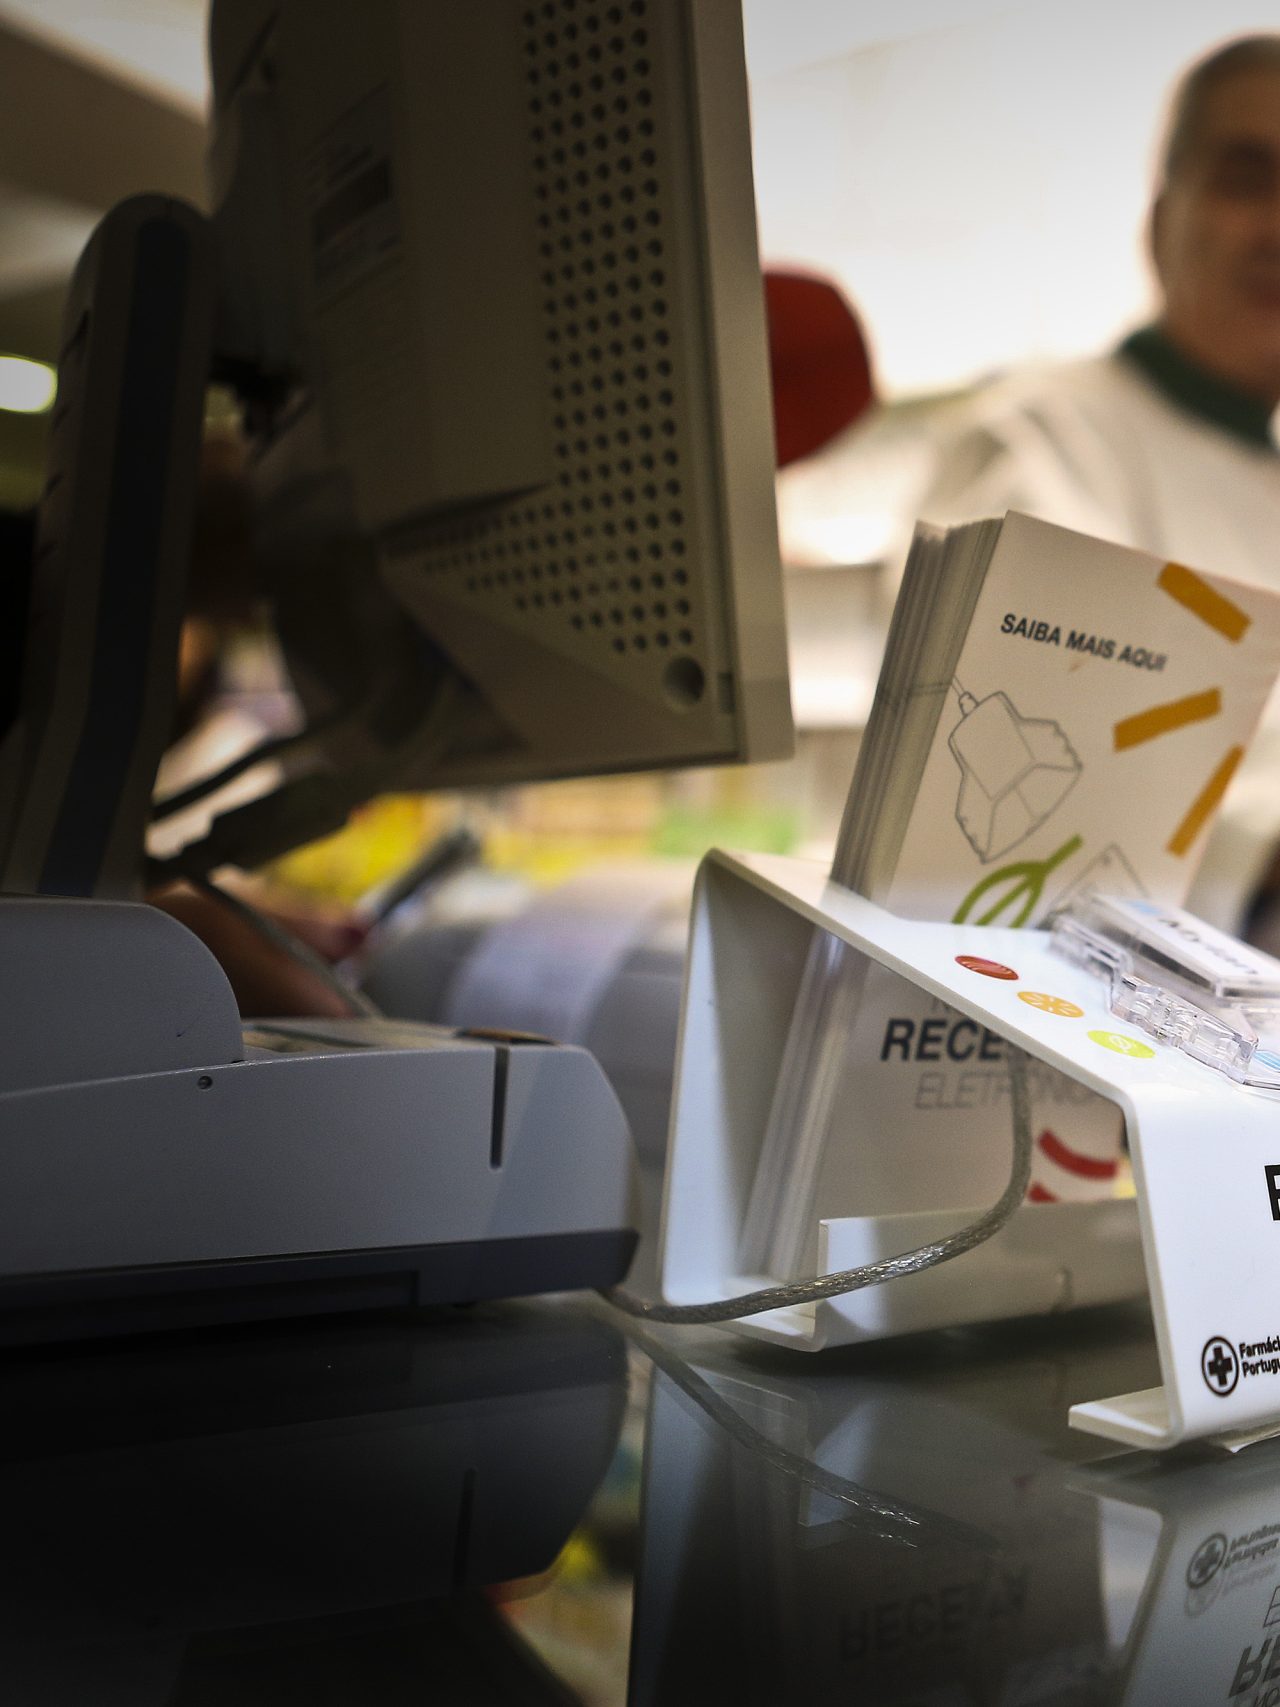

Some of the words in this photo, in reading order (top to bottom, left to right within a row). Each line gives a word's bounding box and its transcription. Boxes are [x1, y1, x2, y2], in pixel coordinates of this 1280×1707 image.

[1001, 613, 1061, 646] SAIBA
[1065, 630, 1117, 660] MAIS
[1119, 646, 1168, 672] AQUI
[880, 1016, 1010, 1062] RECE
